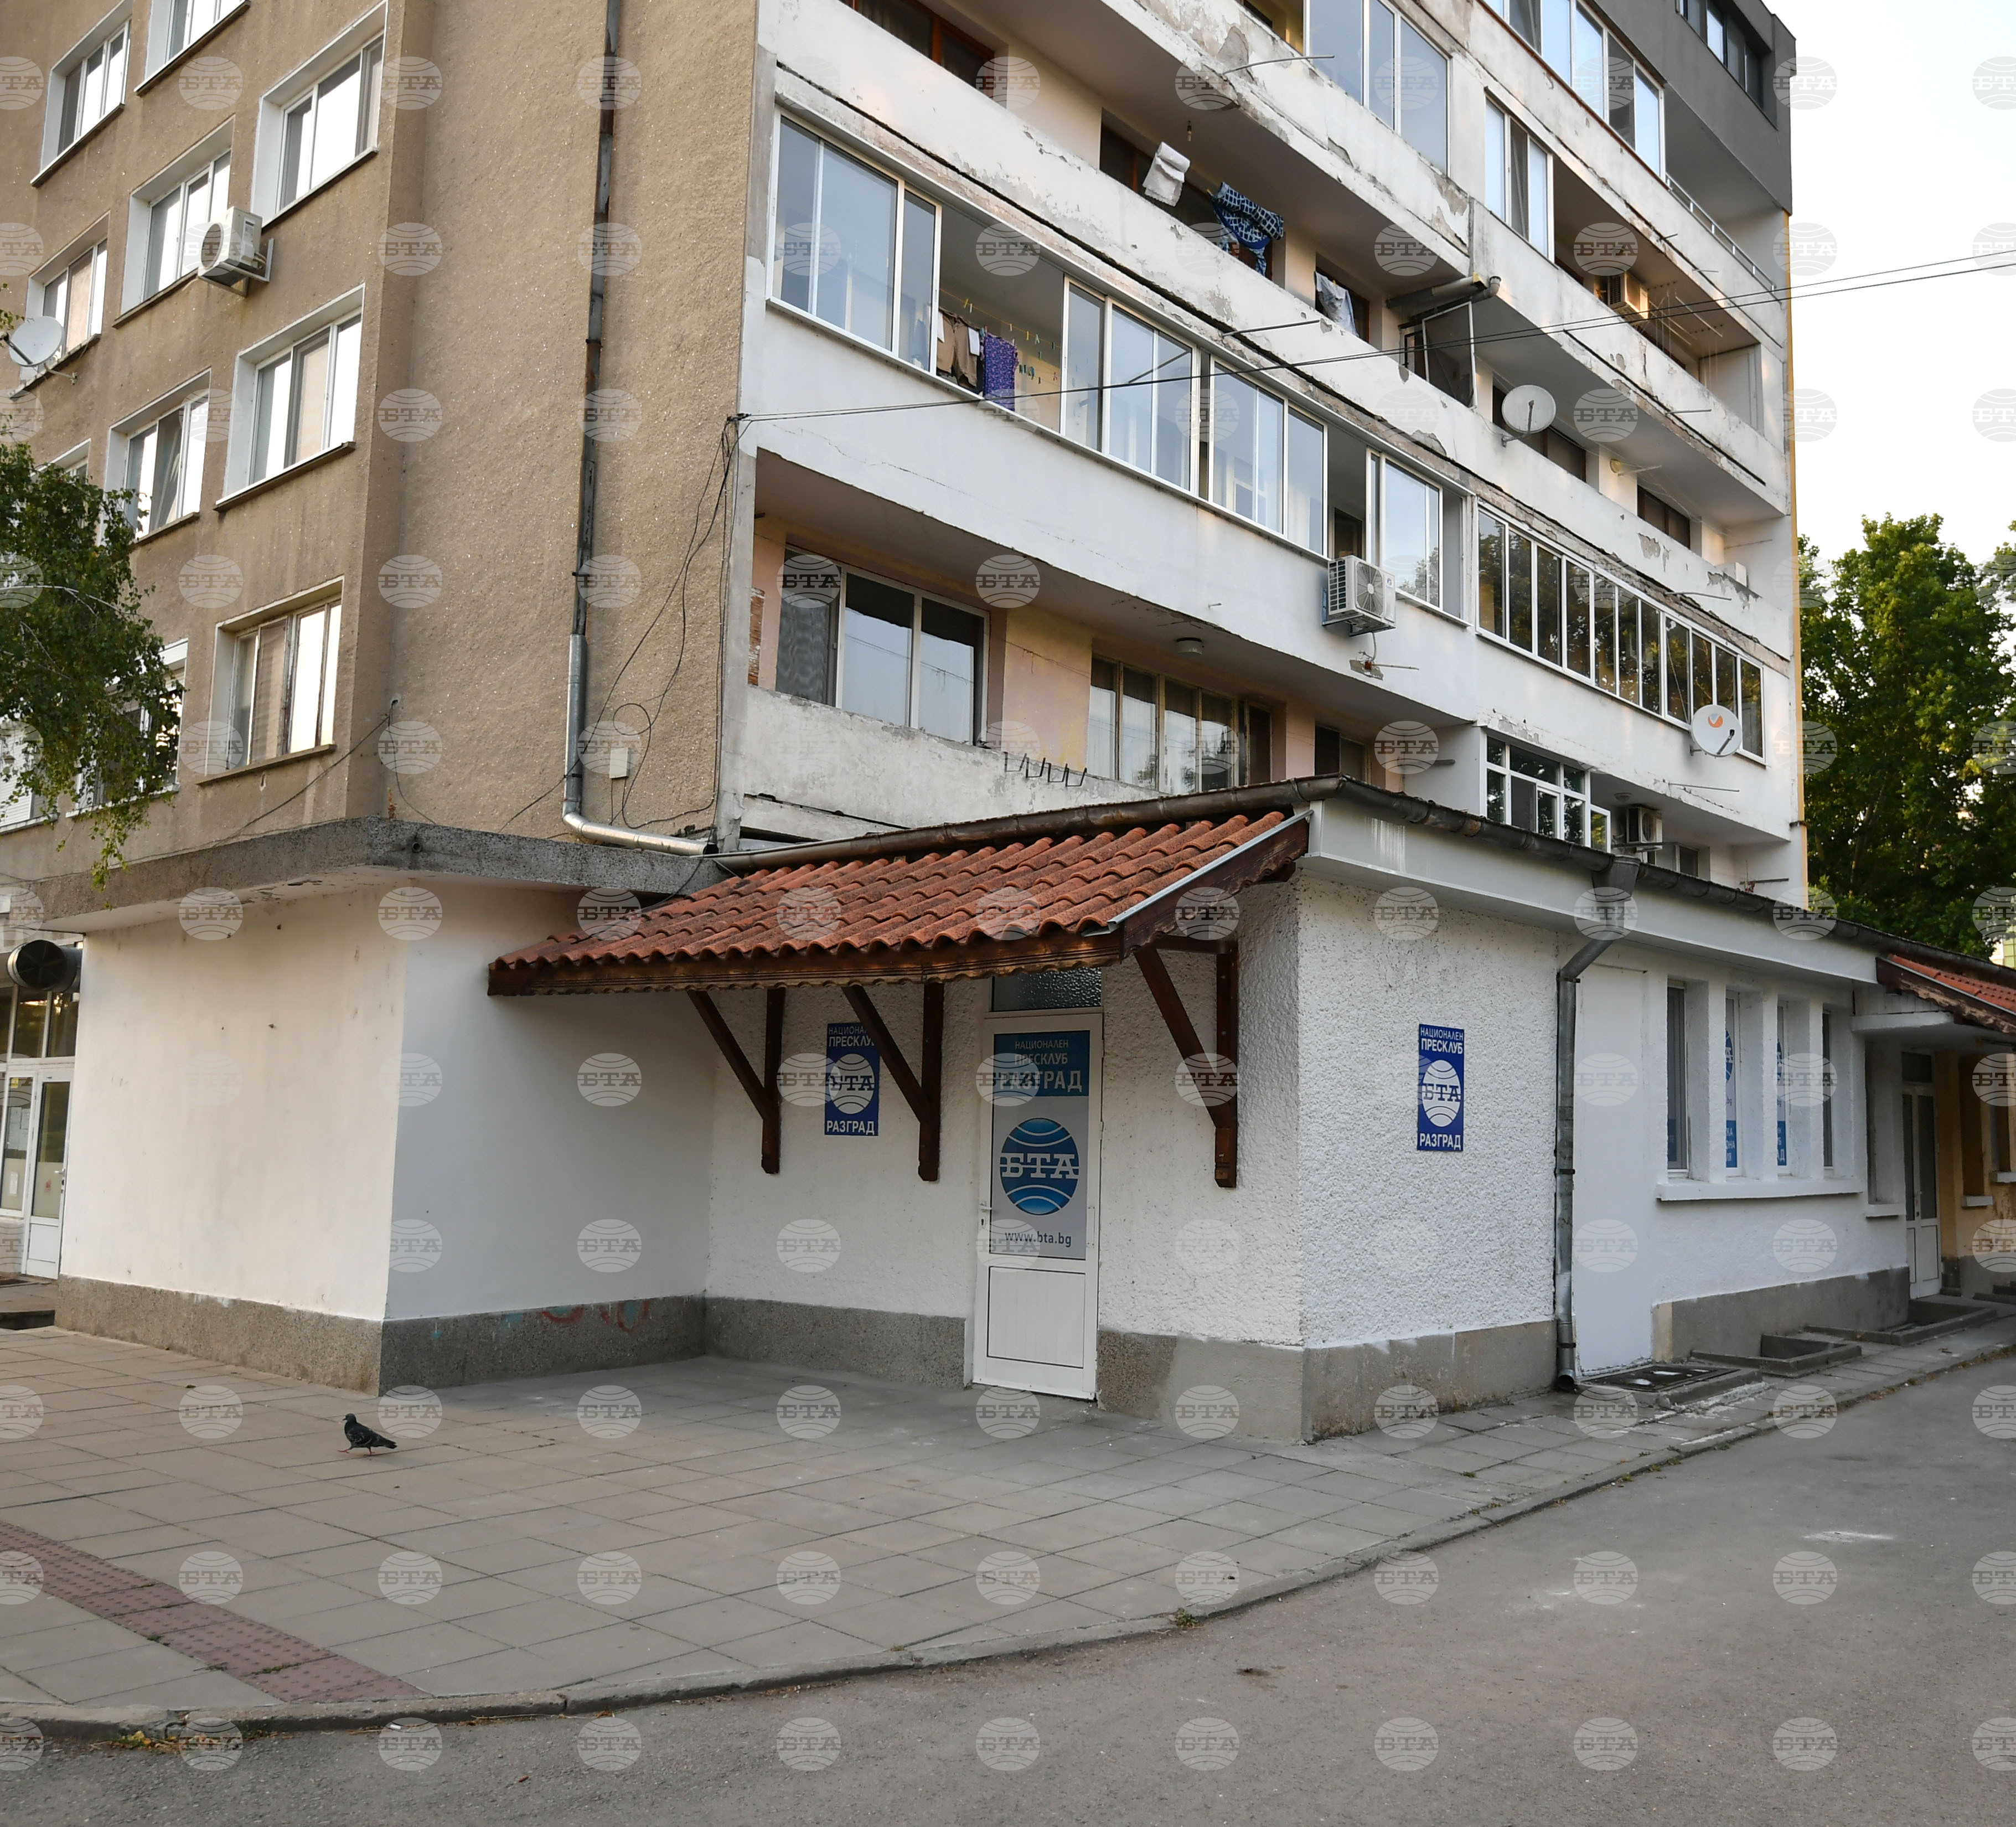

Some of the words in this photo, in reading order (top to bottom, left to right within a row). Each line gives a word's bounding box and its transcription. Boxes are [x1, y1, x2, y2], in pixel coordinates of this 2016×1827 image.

[829, 1026, 867, 1036] НАЦИОНА
[1420, 1027, 1464, 1041] НАЦИОНАЛЕН
[829, 1035, 875, 1047] ПРЕСКЛУ
[1015, 1039, 1069, 1050] НАЦИОНАЛЕН
[1420, 1038, 1464, 1055] ПРЕСКЛУБ
[1014, 1053, 1068, 1066] ПРЕСКЛУБ
[830, 1075, 875, 1091] БТА
[1000, 1070, 1082, 1093] РАЗГРАД
[1421, 1082, 1461, 1103] БТА
[826, 1120, 875, 1136] РАЗГРАД
[1419, 1133, 1461, 1150] РАЗГРАД
[1000, 1152, 1079, 1179] БТА
[1005, 1230, 1072, 1248] www.bta.bg
